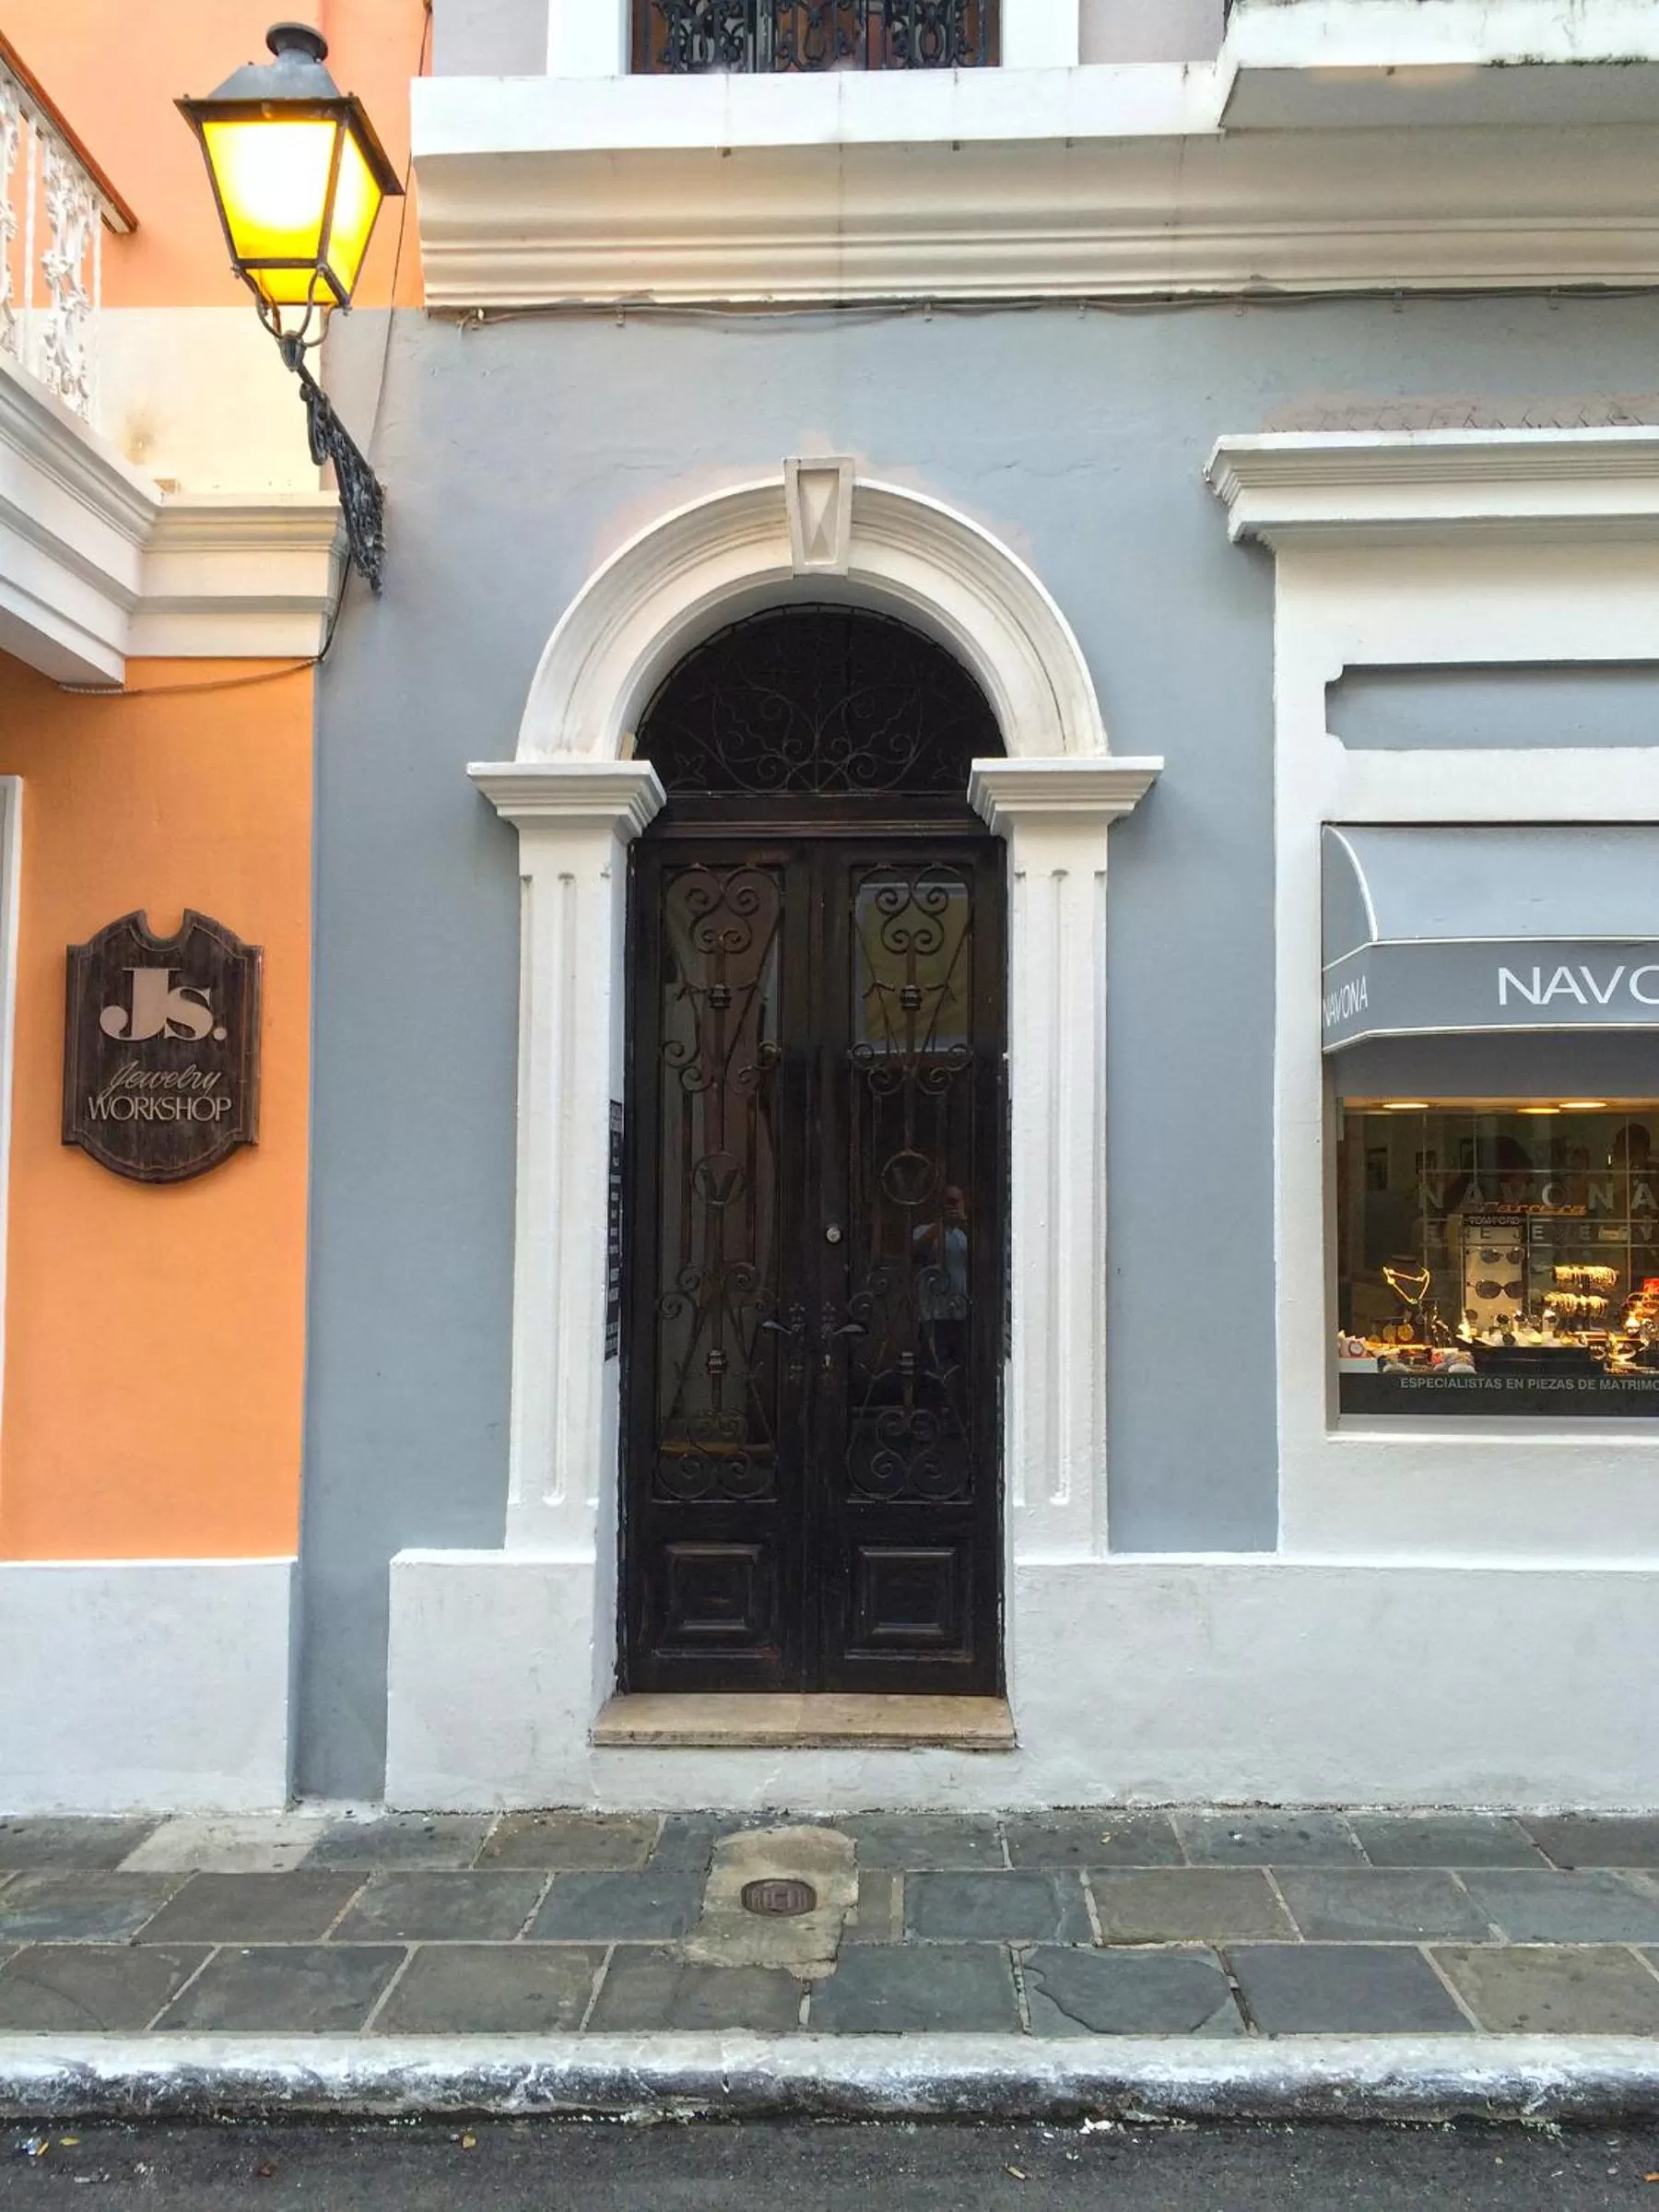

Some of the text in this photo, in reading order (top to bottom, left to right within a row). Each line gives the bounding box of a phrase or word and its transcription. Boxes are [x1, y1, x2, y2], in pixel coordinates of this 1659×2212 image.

[1323, 974, 1368, 1027] NAVONA
[97, 1061, 221, 1101] Jewelry
[88, 1097, 232, 1122] WORKSHOP
[1418, 1182, 1659, 1210] NAVONA
[1400, 1378, 1502, 1389] ESPECIALISTAS
[1506, 1378, 1524, 1390] EN
[1528, 1378, 1574, 1390] PIEZAS
[1578, 1379, 1596, 1390] DE
